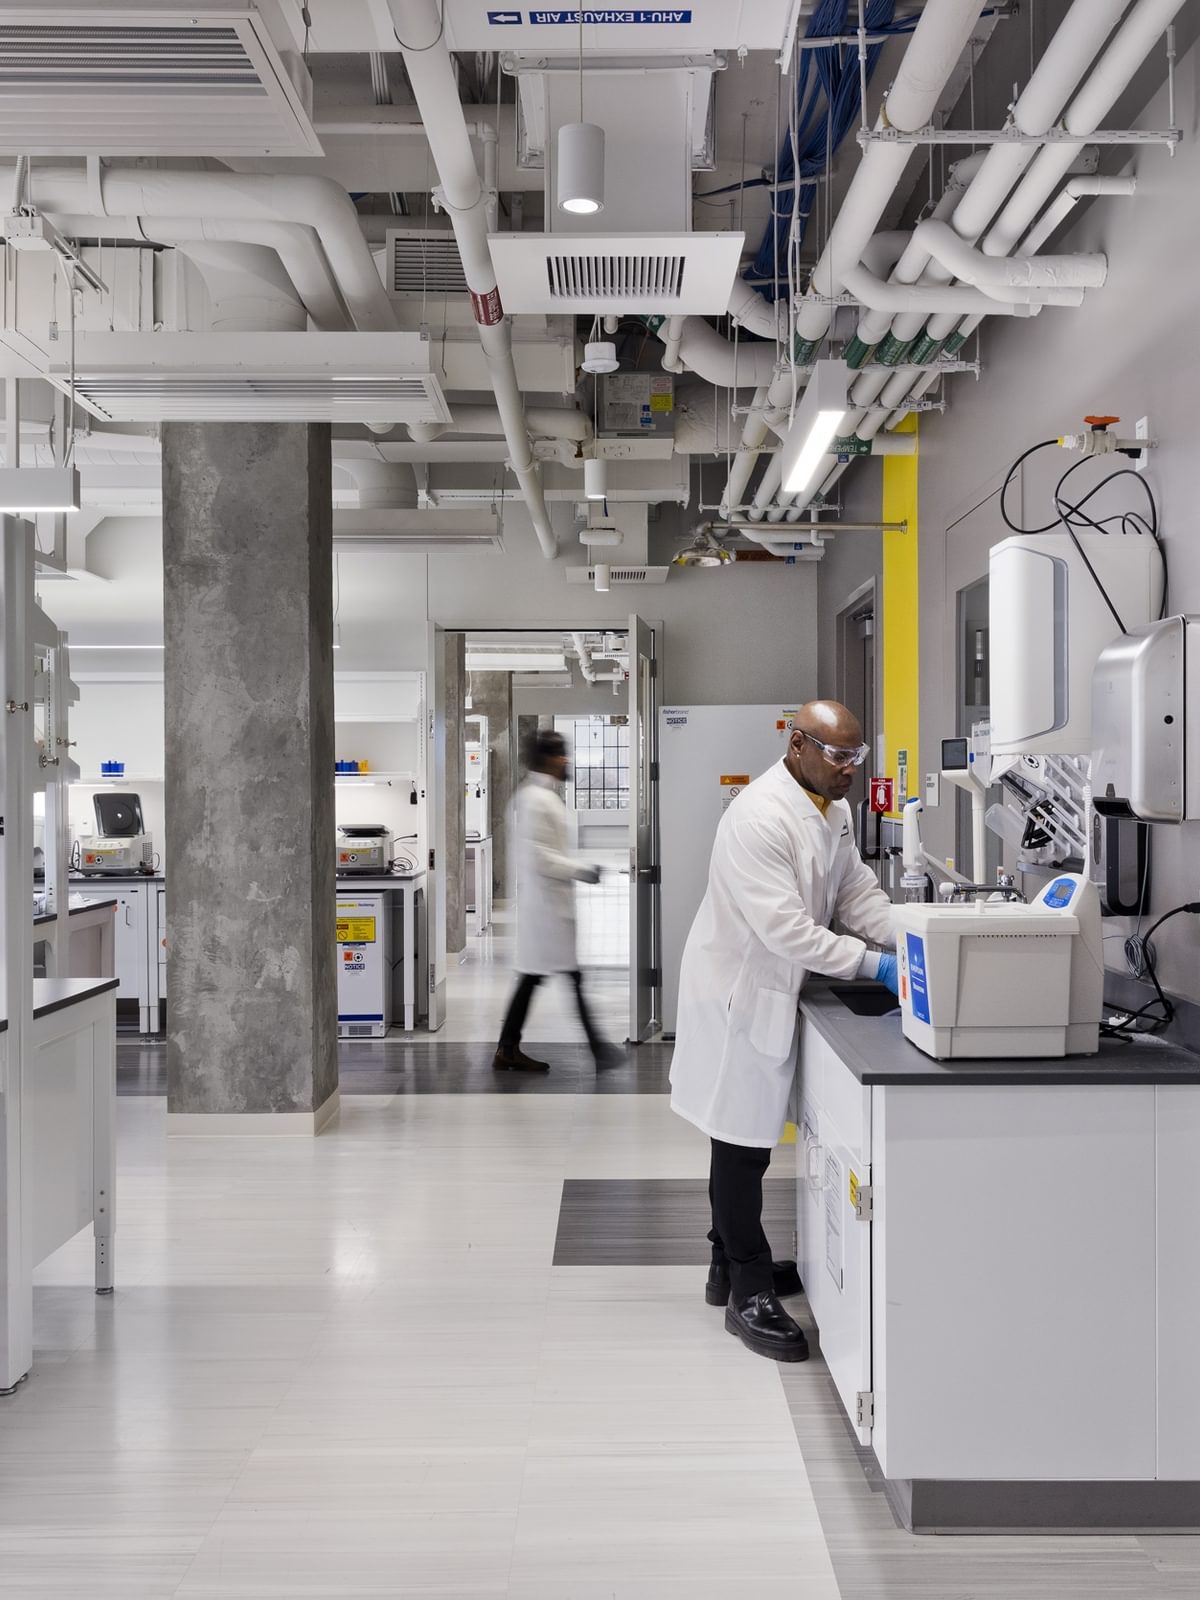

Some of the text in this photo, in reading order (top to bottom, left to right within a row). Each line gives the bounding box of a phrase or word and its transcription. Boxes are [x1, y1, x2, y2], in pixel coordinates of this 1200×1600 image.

[536, 12, 683, 23] AHU-1 EXHAUST AIR
